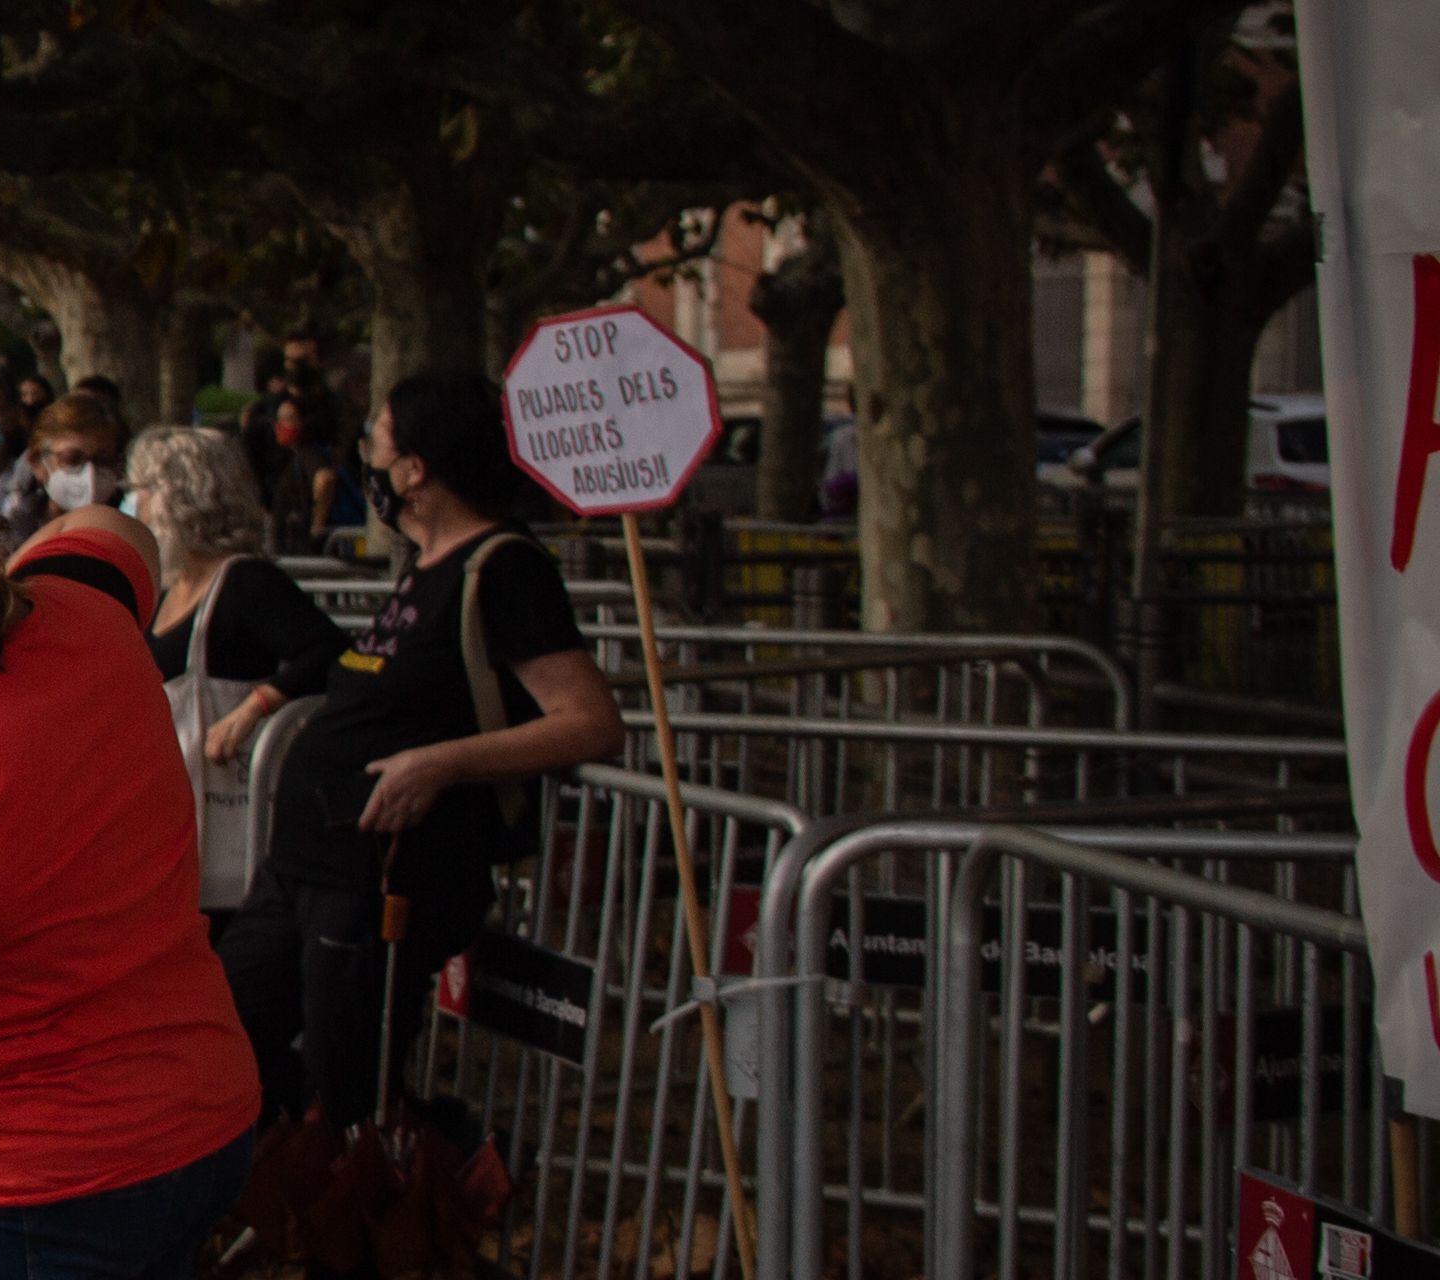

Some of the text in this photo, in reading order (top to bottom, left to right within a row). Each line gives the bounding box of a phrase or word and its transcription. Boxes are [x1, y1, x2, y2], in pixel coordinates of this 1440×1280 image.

[554, 320, 617, 363] STOP
[516, 366, 679, 422] PUJADES DELS
[527, 418, 623, 462] LLOGUERS
